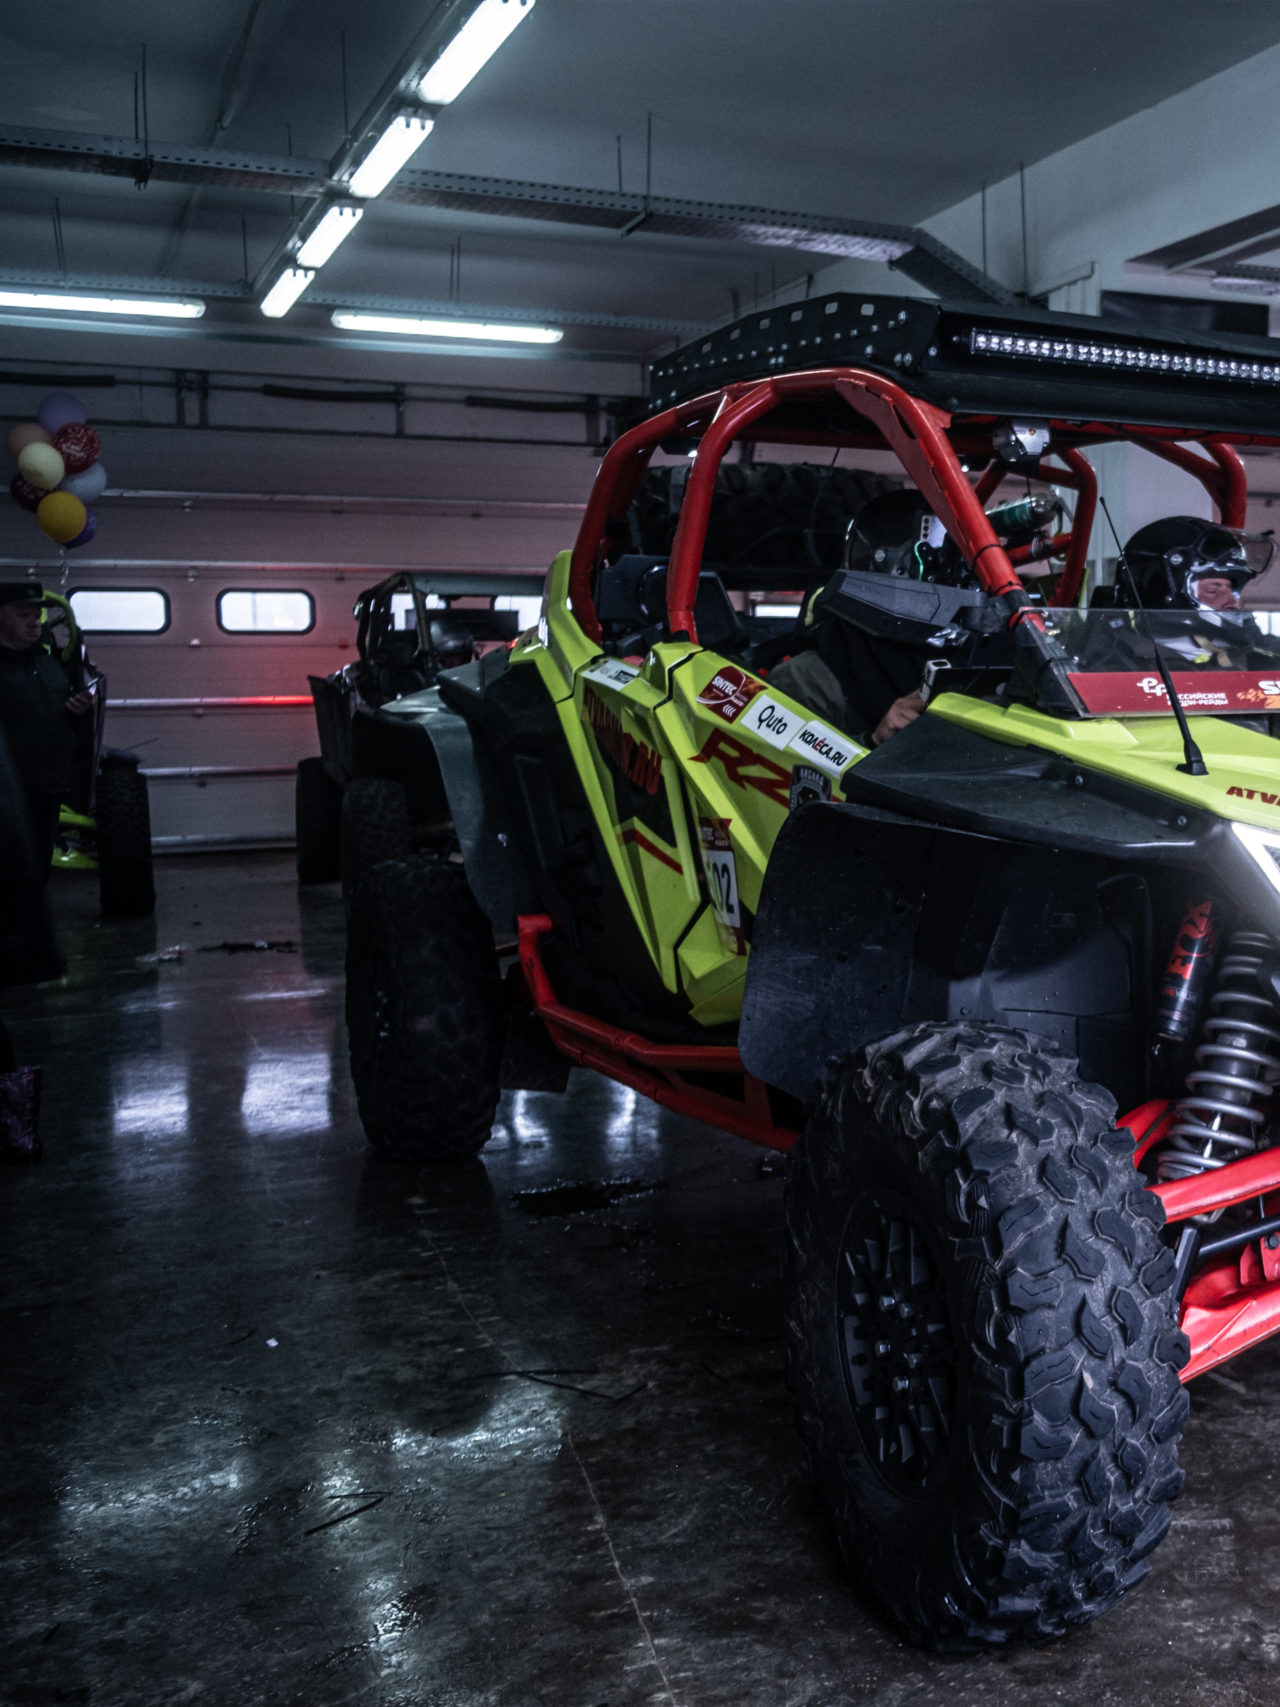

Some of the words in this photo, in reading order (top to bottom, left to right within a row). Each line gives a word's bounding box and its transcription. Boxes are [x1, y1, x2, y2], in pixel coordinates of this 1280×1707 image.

[712, 675, 738, 696] SINTEC
[757, 705, 788, 735] Quto
[1165, 900, 1213, 981] FOX
